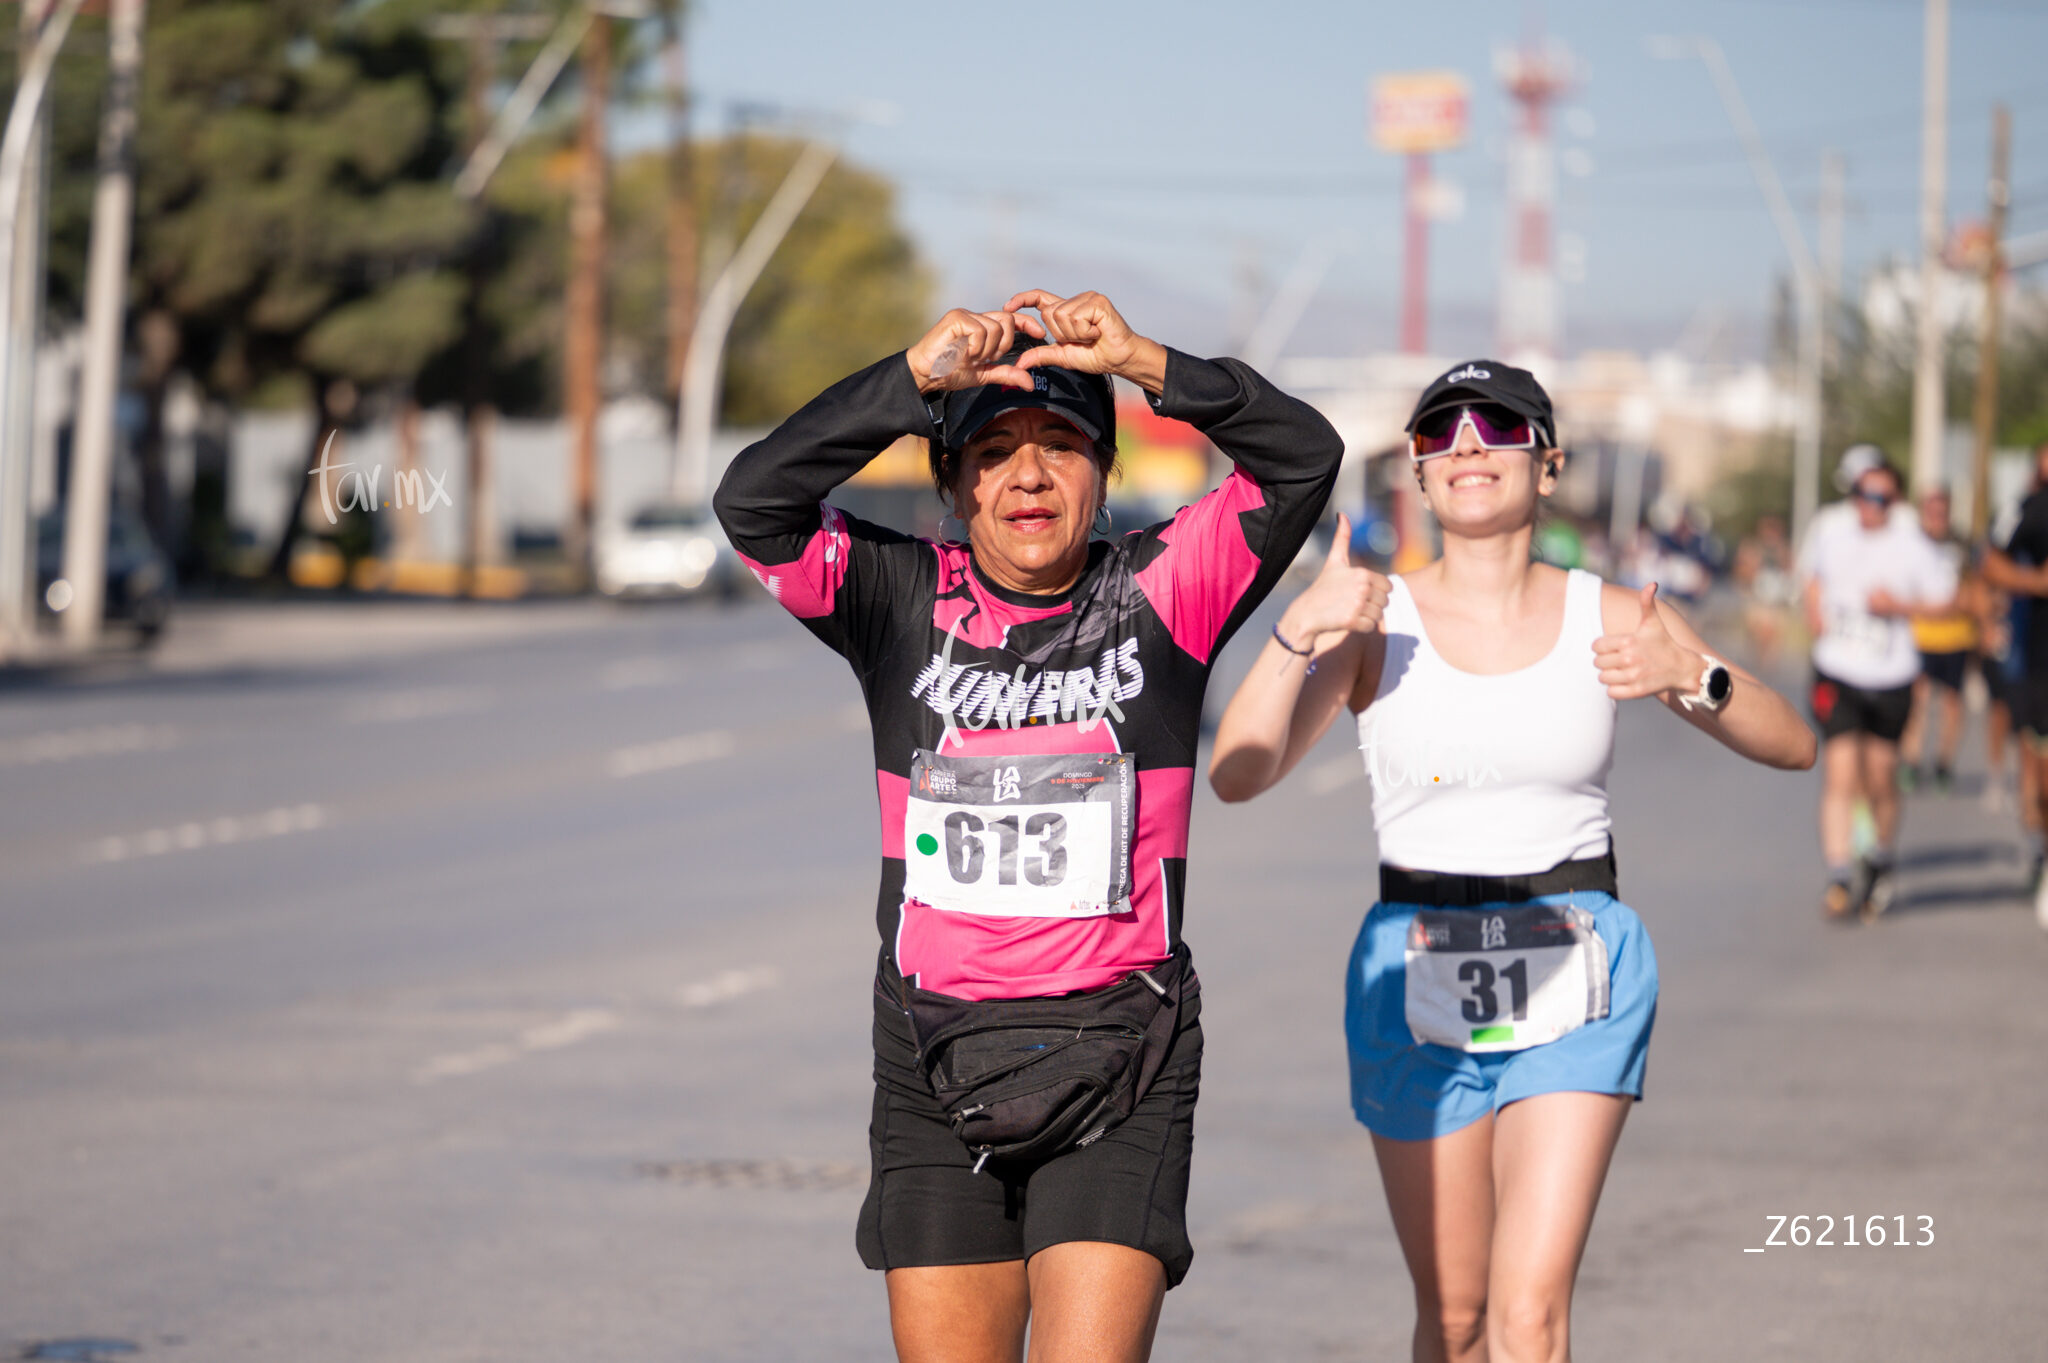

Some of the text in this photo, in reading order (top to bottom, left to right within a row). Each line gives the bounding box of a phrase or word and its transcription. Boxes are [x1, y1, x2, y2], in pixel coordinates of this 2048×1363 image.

[1448, 364, 1491, 383] alo
[931, 775, 957, 785] GRUPO
[930, 782, 957, 791] ARTEC
[1121, 827, 1129, 839] DE
[944, 811, 1067, 887] 613
[1120, 840, 1128, 853] KIT
[1120, 855, 1128, 866] DE
[1458, 959, 1528, 1024] 31
